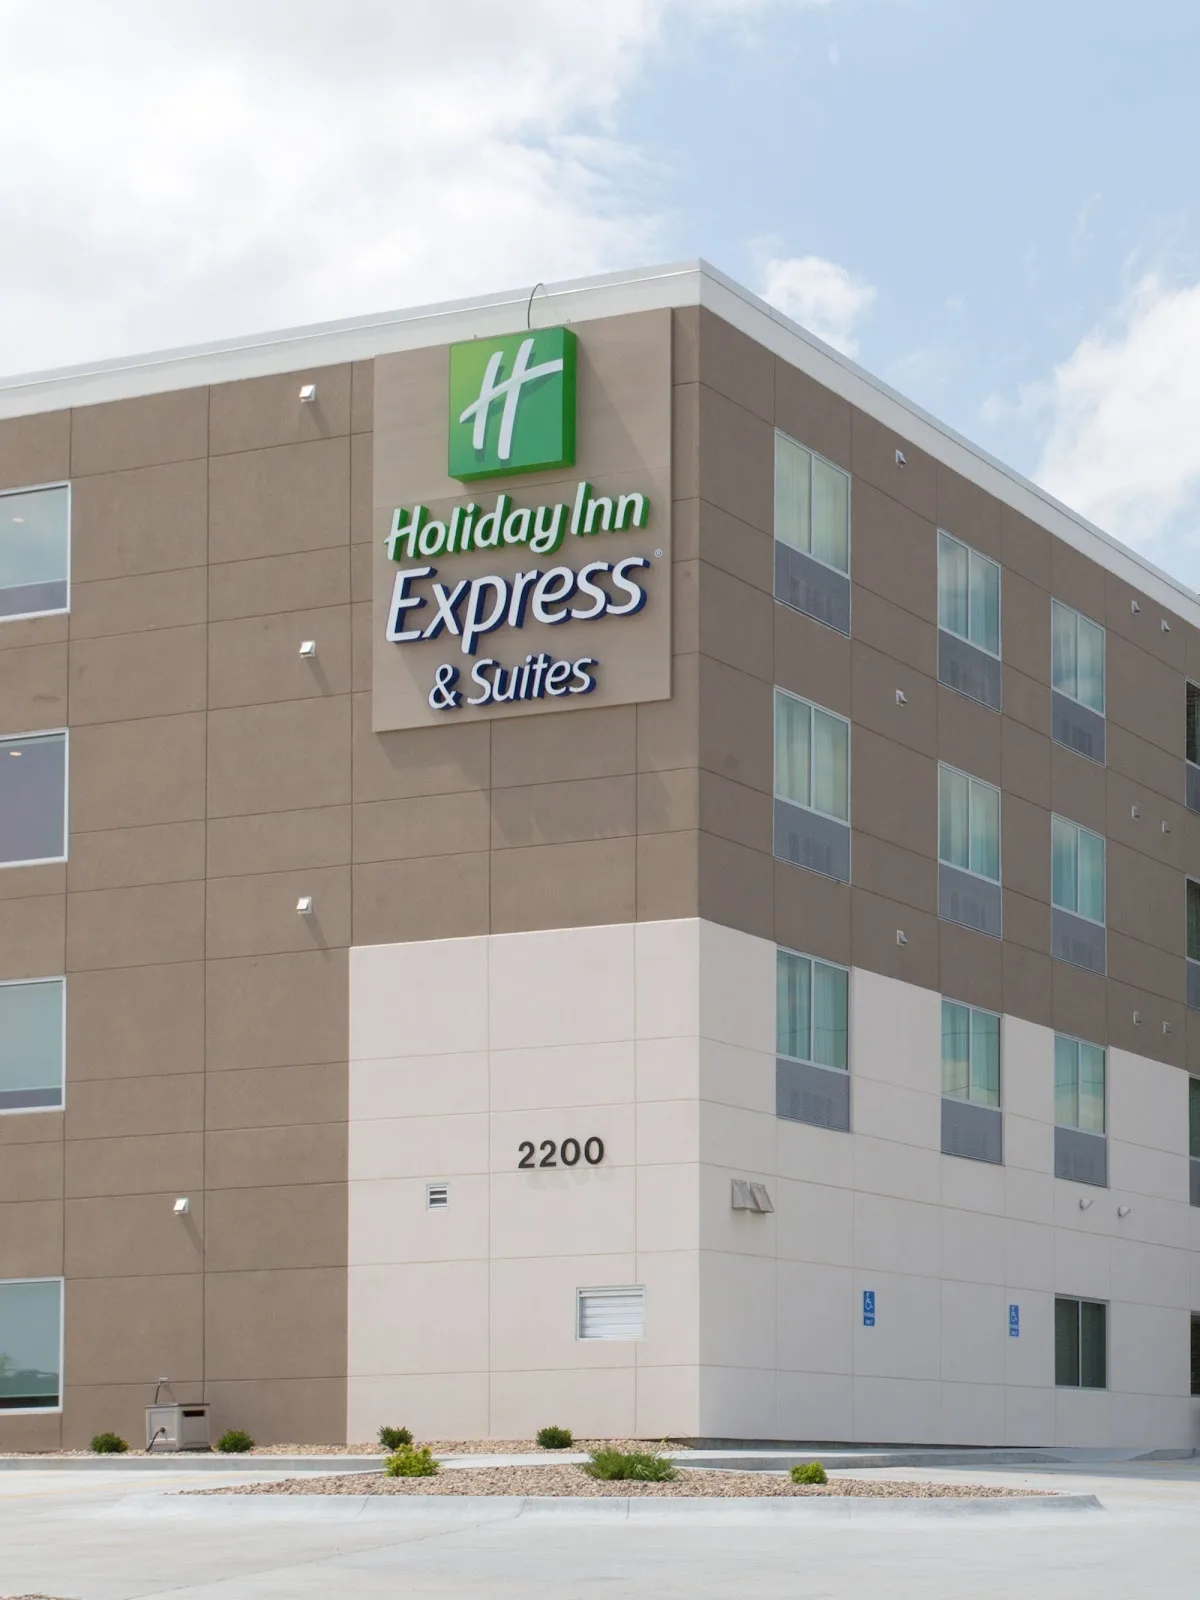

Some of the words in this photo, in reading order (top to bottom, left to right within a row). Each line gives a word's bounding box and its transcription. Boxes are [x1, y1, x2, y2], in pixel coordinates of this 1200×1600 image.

[459, 338, 563, 460] H
[384, 494, 569, 561] Holiday
[571, 481, 650, 537] Inn
[386, 556, 651, 655] Express
[428, 662, 462, 712] &
[467, 653, 599, 706] Suites
[517, 1136, 605, 1169] 2200
